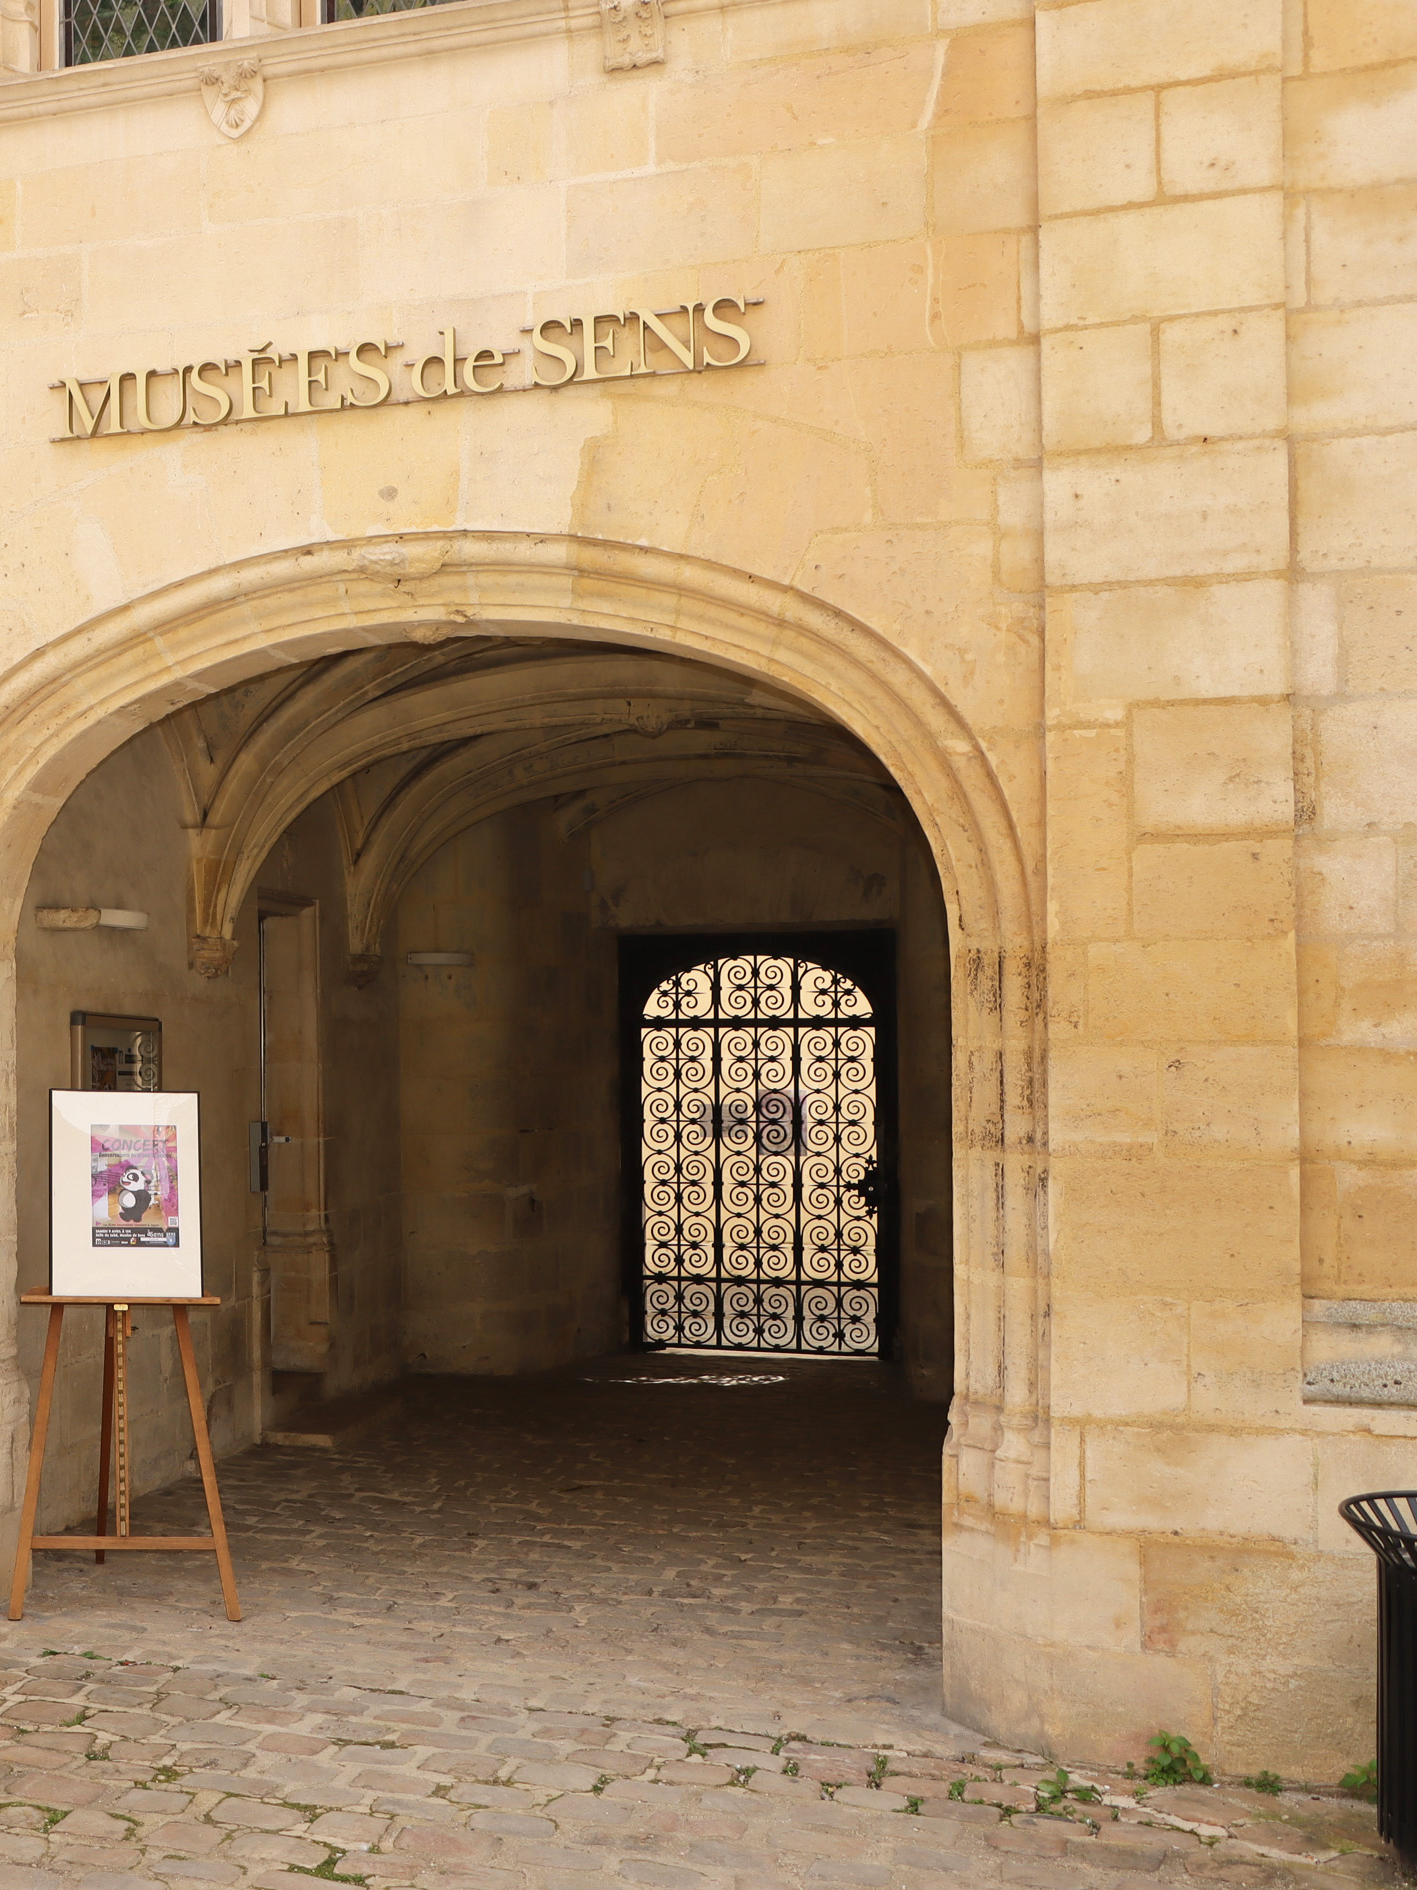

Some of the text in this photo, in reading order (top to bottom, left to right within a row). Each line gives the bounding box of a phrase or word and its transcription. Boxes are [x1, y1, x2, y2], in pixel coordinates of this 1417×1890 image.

[62, 295, 753, 438] MUSÉES de SENS
